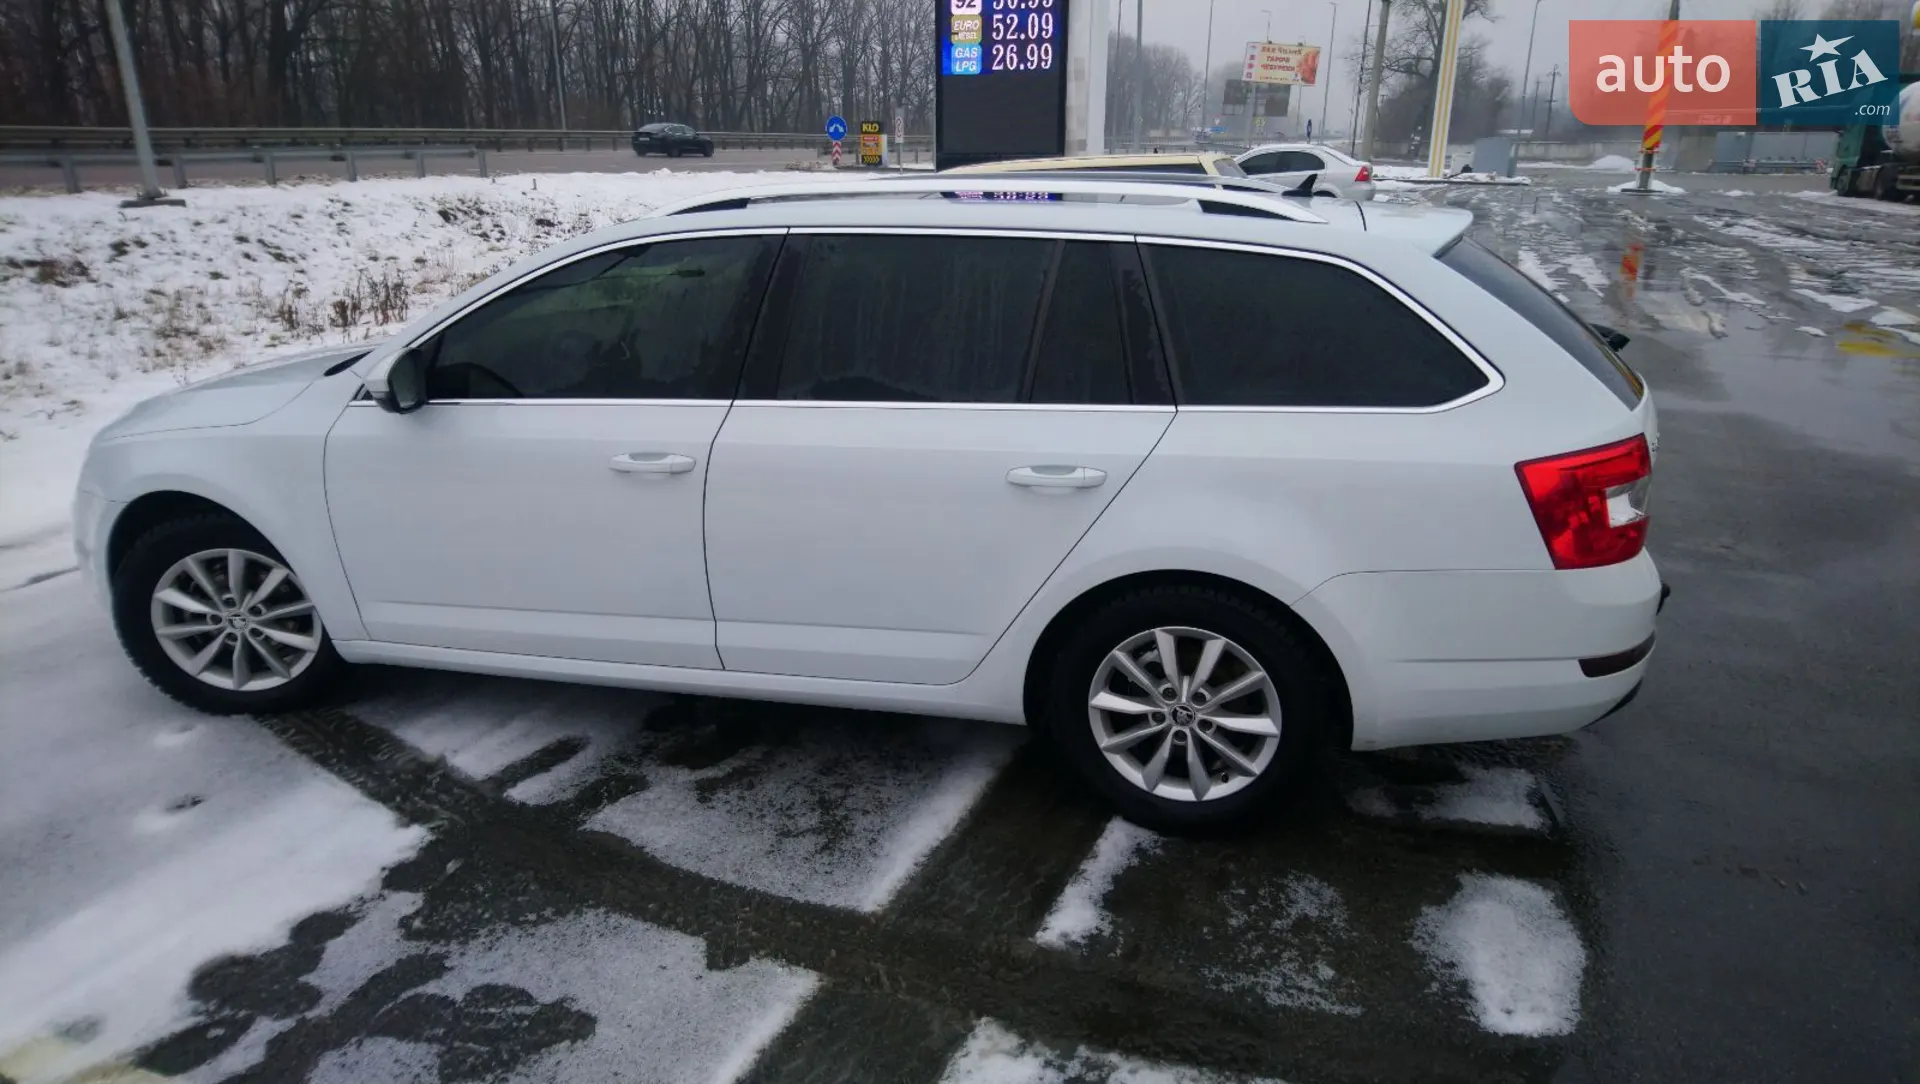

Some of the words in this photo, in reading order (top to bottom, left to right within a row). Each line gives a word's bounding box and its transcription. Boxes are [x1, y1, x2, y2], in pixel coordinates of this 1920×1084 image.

[954, 20, 979, 31] EURO
[992, 13, 1053, 40] 52.09
[955, 47, 978, 59] GAS
[992, 43, 1053, 70] 26.99
[955, 60, 977, 72] LPG
[862, 123, 880, 133] KLO
